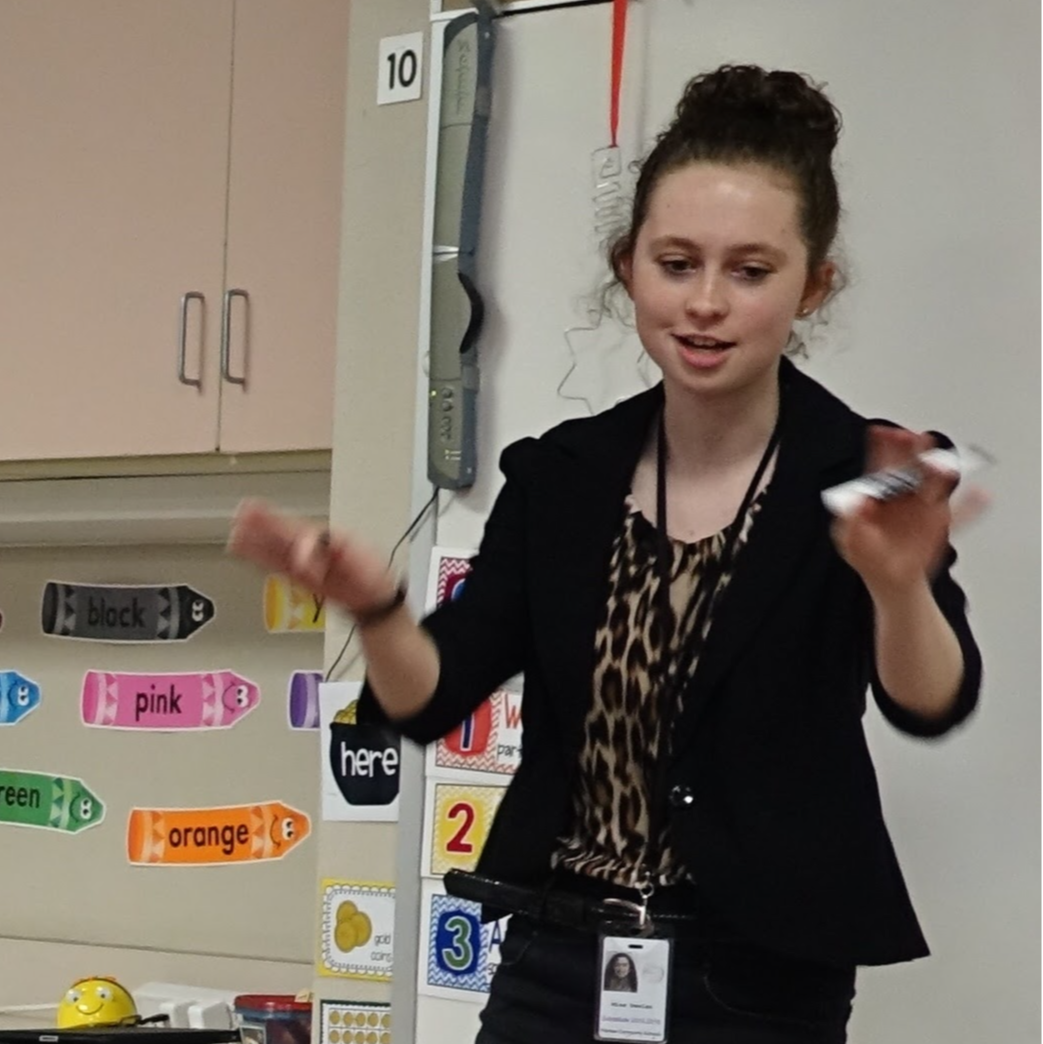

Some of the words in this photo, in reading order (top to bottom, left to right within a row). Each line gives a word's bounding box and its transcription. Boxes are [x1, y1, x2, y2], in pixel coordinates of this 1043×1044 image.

[386, 49, 417, 90] 10
[87, 598, 147, 629] black
[135, 686, 183, 715] pink
[340, 742, 399, 777] here
[168, 819, 249, 853] orange
[446, 802, 476, 853] 2
[374, 933, 391, 947] gold
[442, 915, 473, 971] 3
